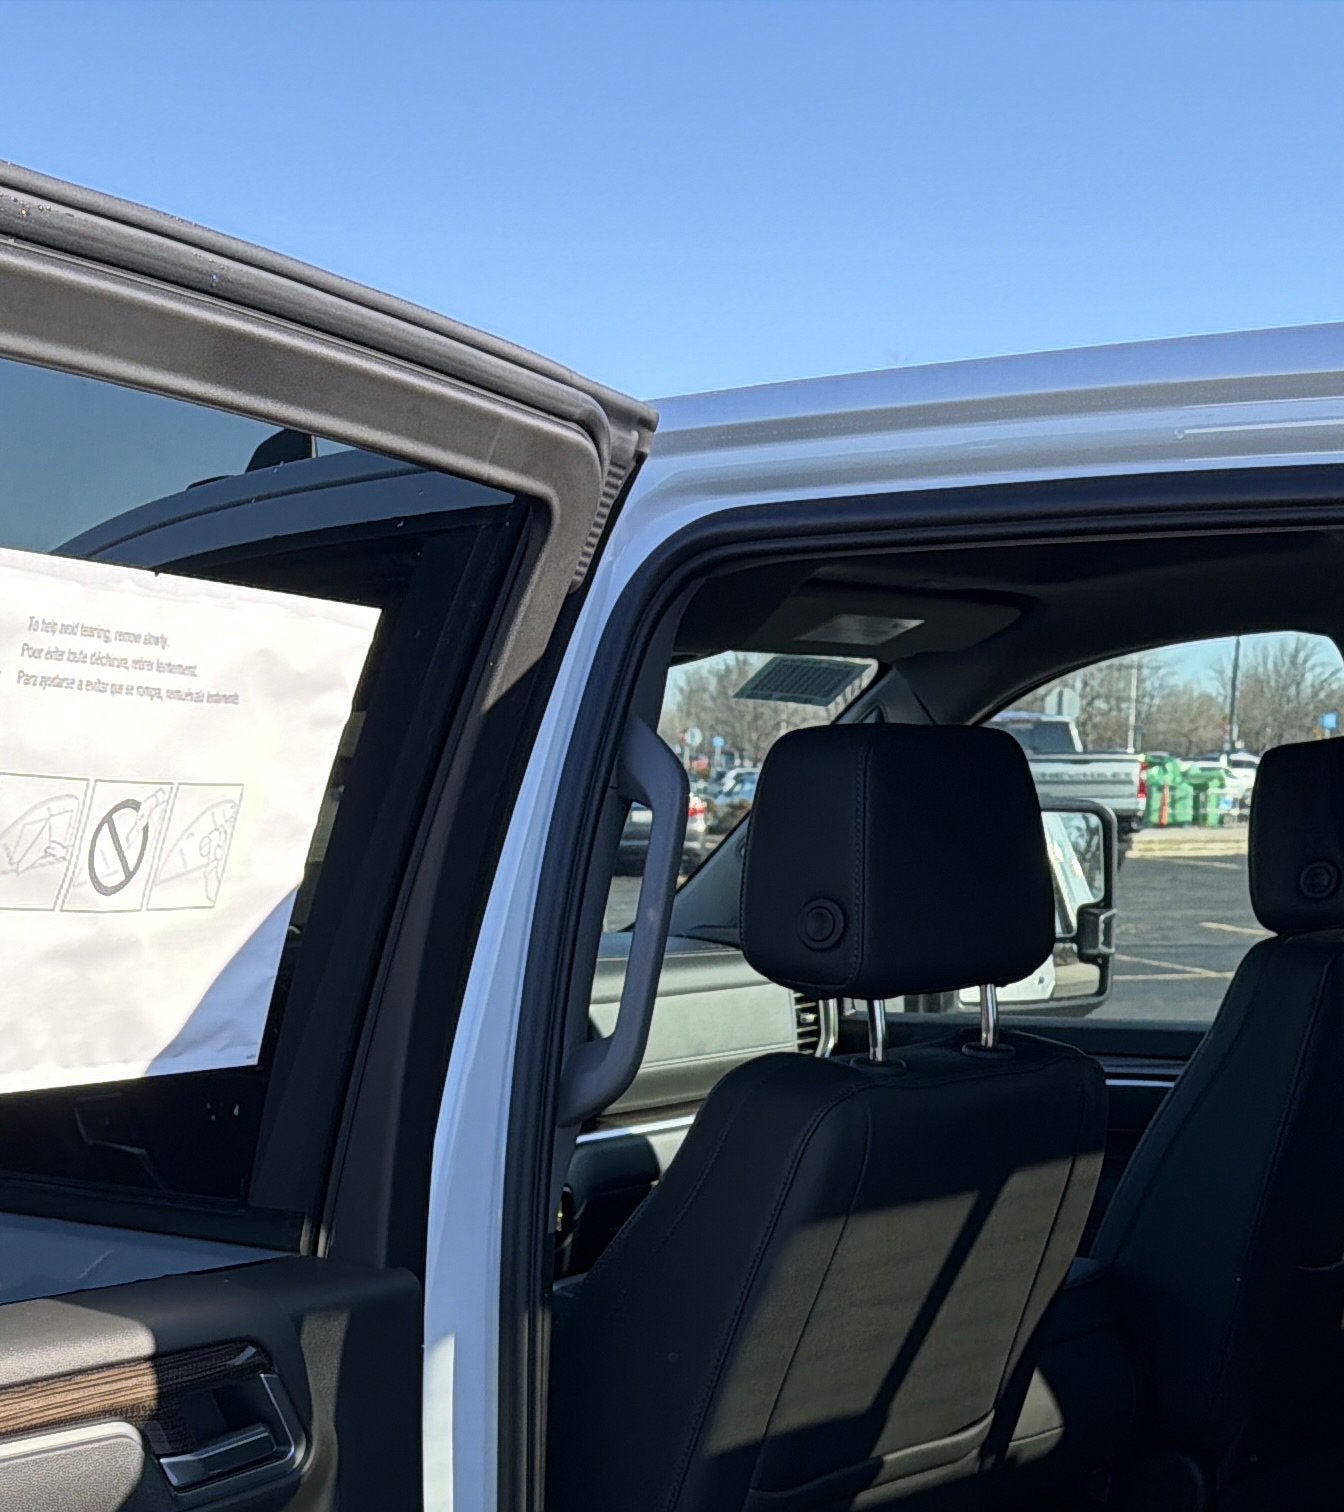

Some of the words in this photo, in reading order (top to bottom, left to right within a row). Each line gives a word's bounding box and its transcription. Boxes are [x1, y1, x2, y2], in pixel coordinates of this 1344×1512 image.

[27, 616, 40, 632] To
[41, 618, 58, 636] help
[20, 642, 45, 660] Pour
[16, 670, 38, 687] Para
[76, 679, 83, 691] a
